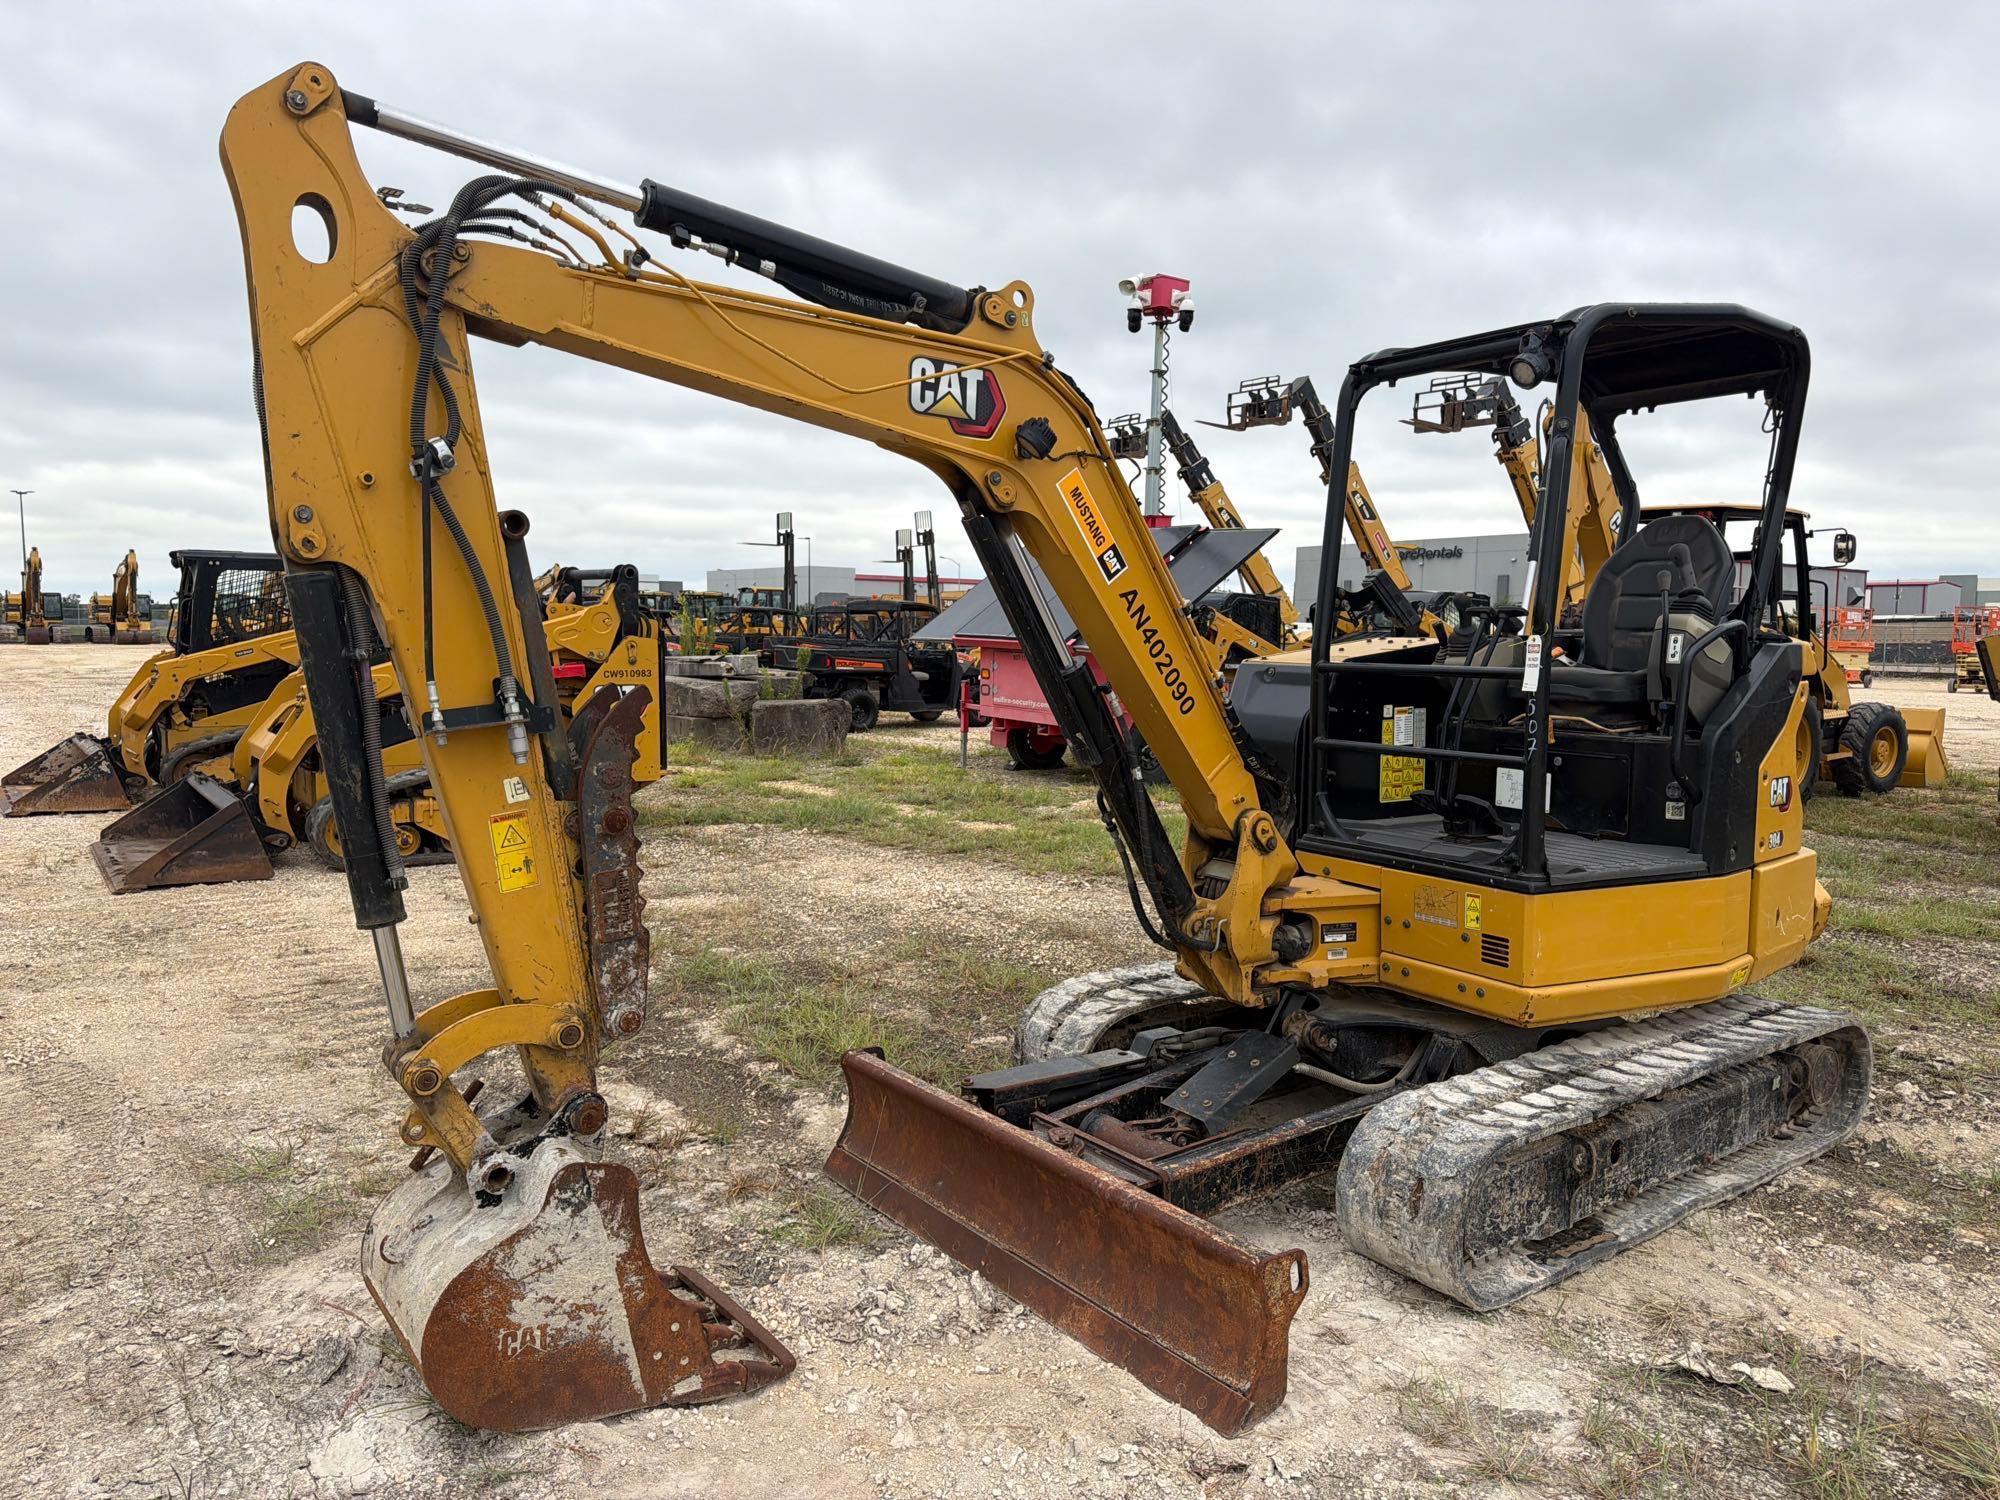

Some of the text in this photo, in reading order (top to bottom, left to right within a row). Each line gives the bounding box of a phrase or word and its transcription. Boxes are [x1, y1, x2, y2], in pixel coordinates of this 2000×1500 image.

[911, 357, 984, 421] CAT
[1069, 486, 1122, 574] MUSTANG CAT
[1399, 545, 1463, 561] ercRentals
[1119, 589, 1196, 715] AN402090
[603, 669, 653, 678] CW910983
[1770, 776, 1789, 806] CAT
[1768, 831, 1782, 850] 304
[501, 1323, 550, 1360] CAT
